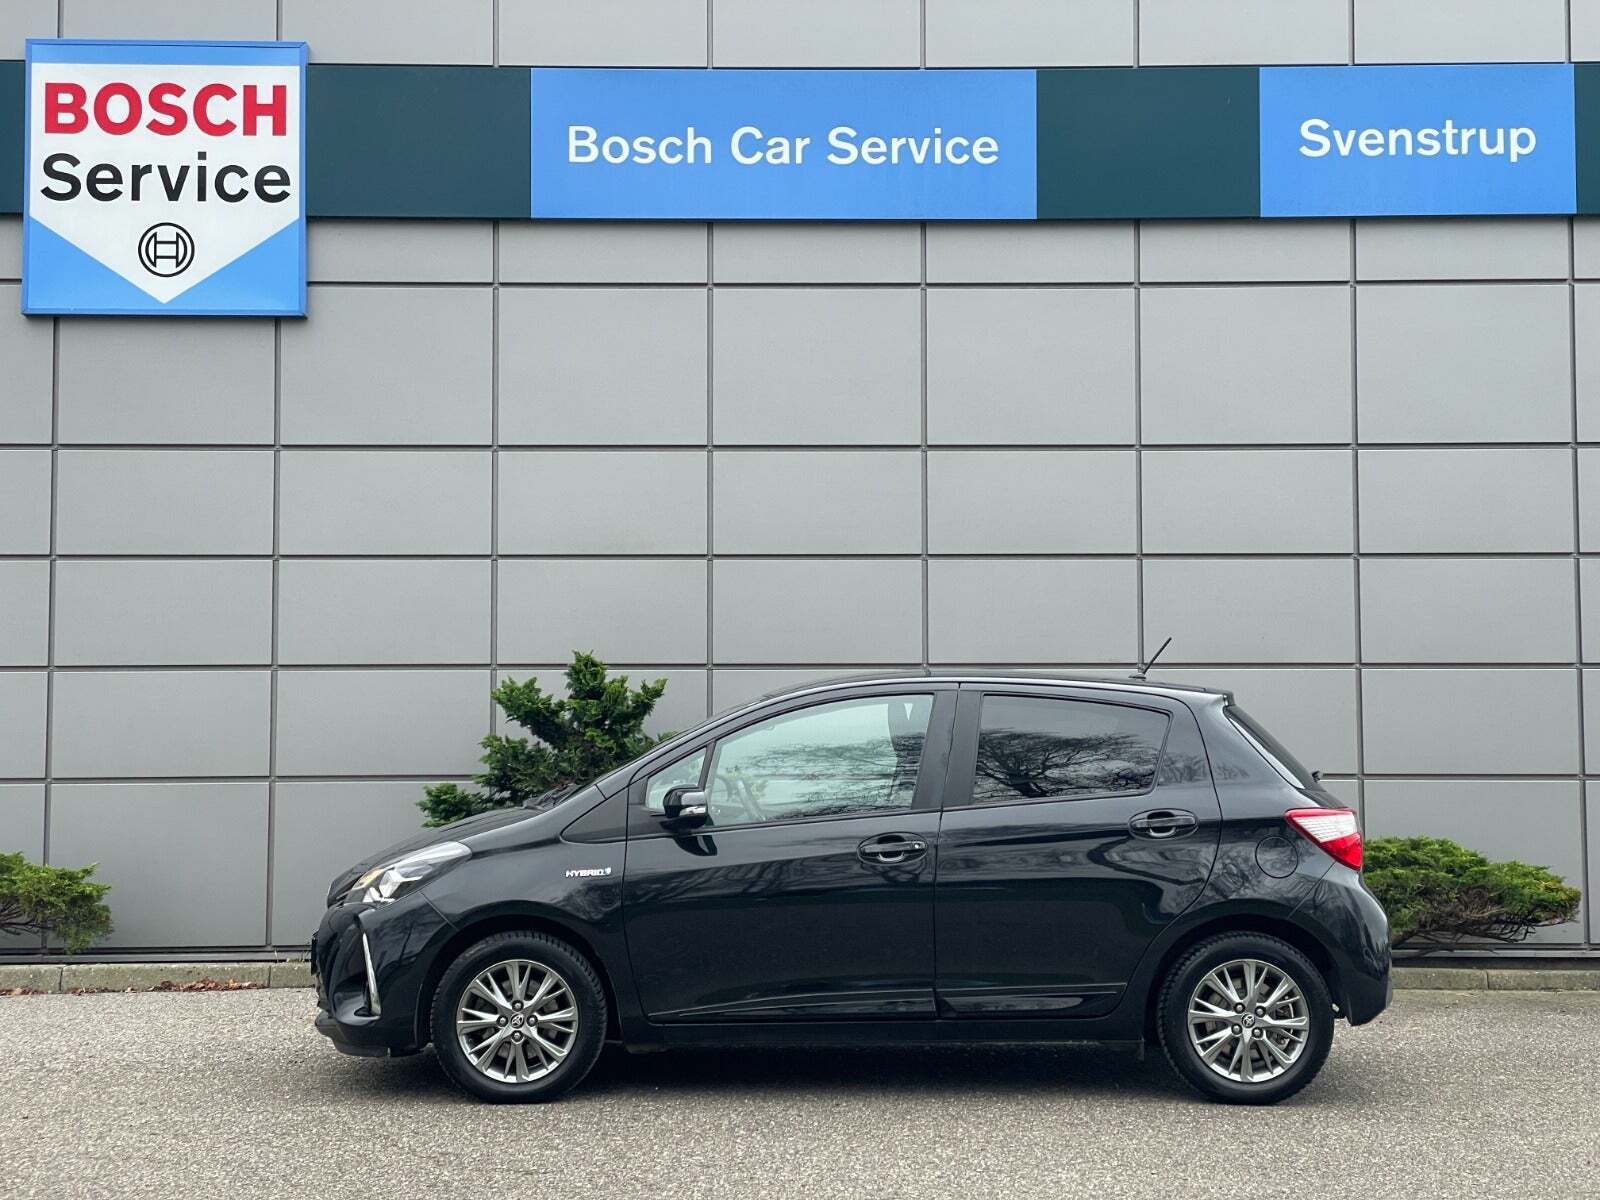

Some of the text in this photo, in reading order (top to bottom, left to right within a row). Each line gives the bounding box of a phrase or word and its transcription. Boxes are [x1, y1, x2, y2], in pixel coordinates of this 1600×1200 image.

[44, 82, 287, 137] BOSCH
[567, 124, 999, 165] Bosch Car Service
[1299, 118, 1537, 163] Svenstrup
[40, 151, 291, 204] Service
[565, 869, 604, 878] HYBRID
